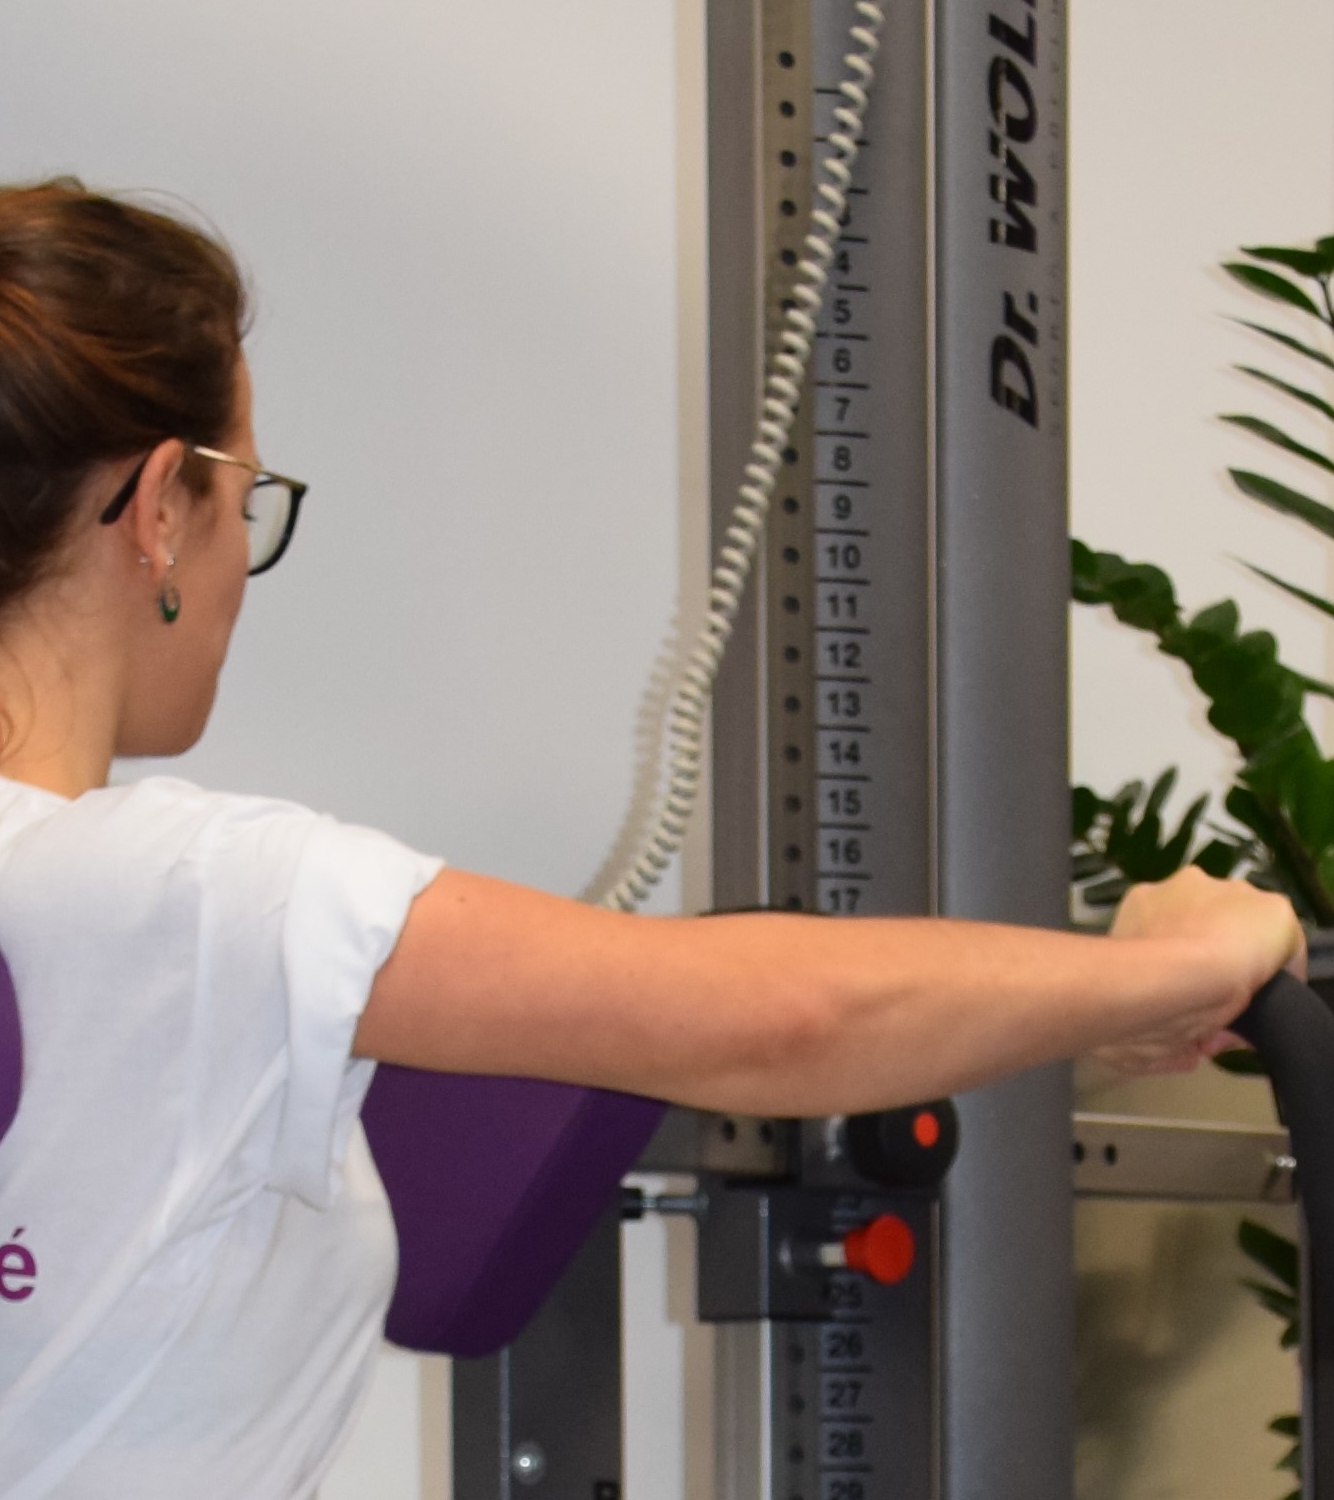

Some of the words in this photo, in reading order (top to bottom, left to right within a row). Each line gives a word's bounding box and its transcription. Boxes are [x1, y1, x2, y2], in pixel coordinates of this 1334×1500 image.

[833, 299, 851, 324] 5
[833, 348, 851, 373] 6
[988, 290, 1041, 431] Dr.
[833, 397, 851, 422] 7
[833, 446, 851, 471] 8
[833, 495, 851, 520] 9
[826, 544, 860, 569] 10
[826, 593, 860, 618] 11
[827, 642, 861, 667] 12
[827, 691, 861, 716] 13
[828, 740, 861, 765] 14
[828, 789, 861, 814] 15
[829, 838, 862, 863] 16
[827, 1334, 862, 1359] 26
[827, 1383, 862, 1408] 27
[827, 1432, 862, 1457] 28
